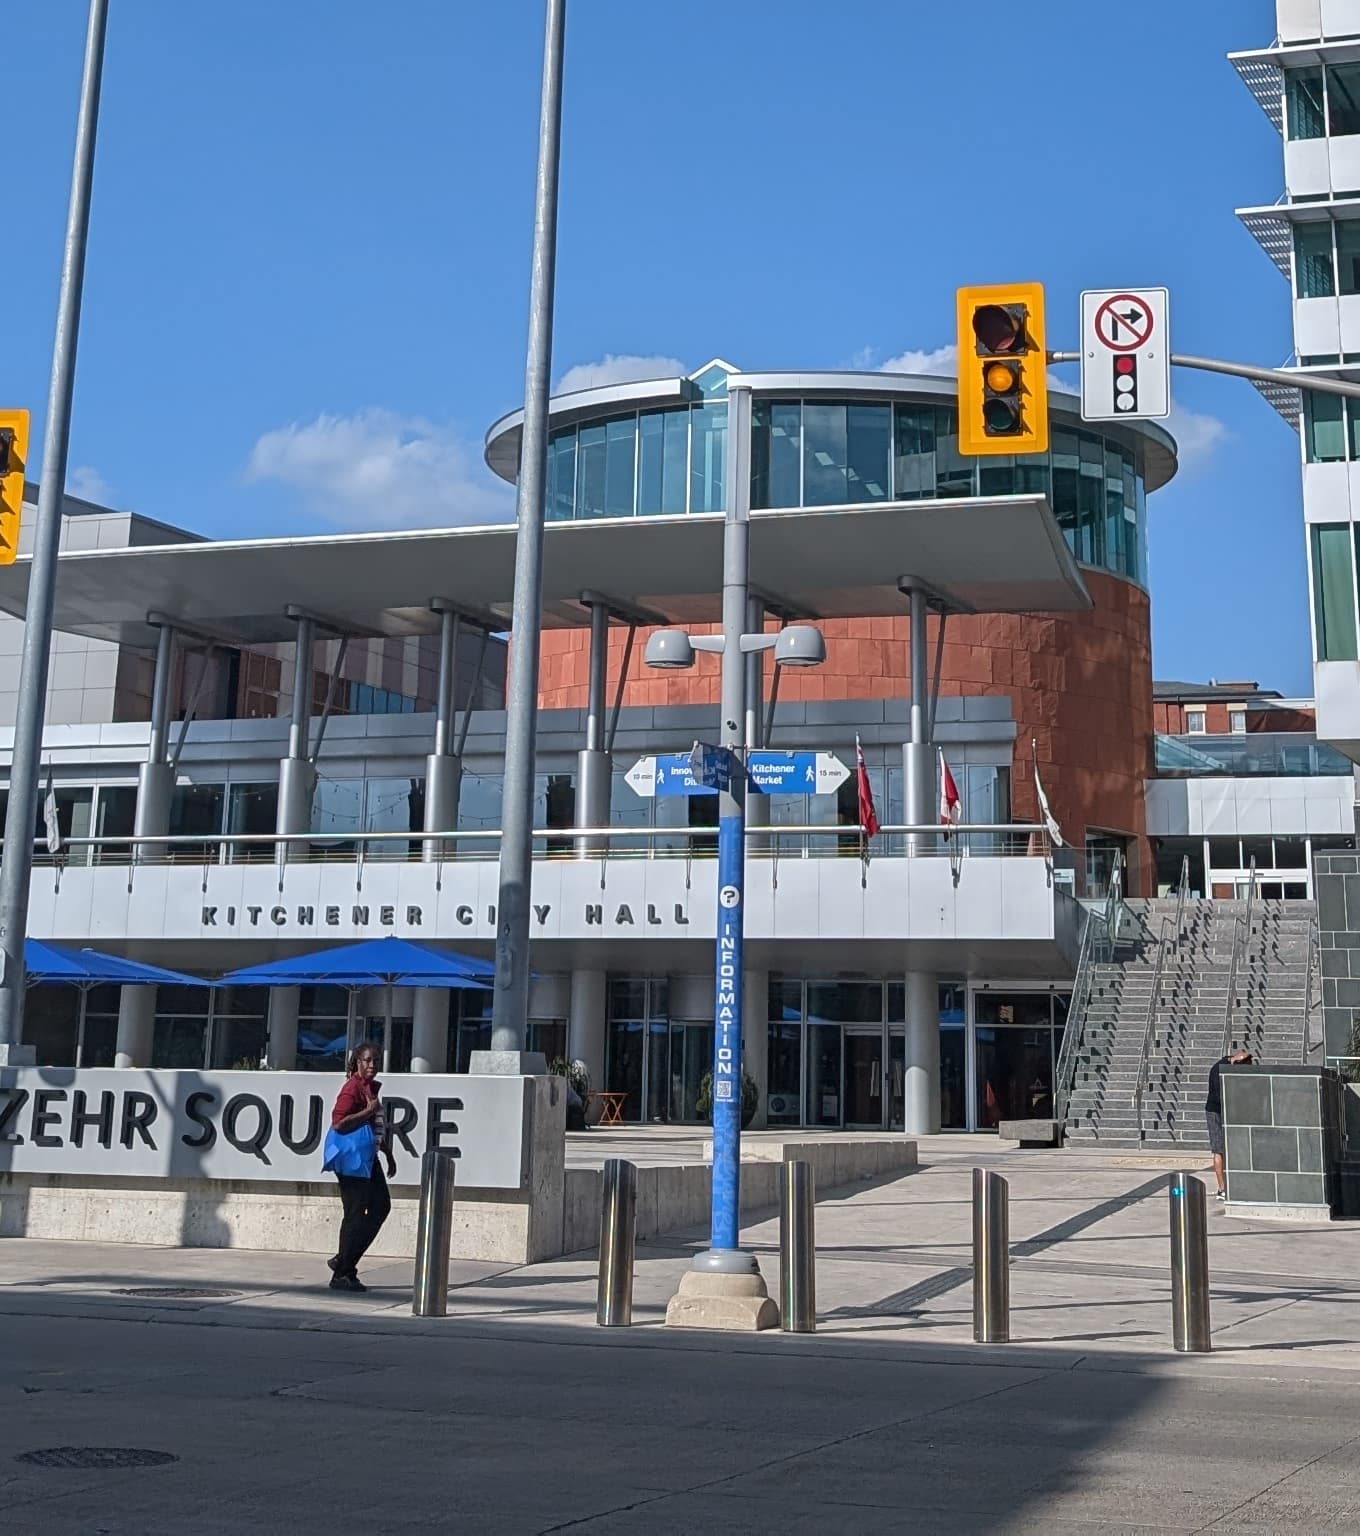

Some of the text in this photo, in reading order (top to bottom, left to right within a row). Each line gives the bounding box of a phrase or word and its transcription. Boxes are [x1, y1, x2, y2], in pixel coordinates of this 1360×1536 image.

[752, 764, 795, 773] Kitchener
[202, 904, 689, 925] KITCHENER CIY HALL
[717, 923, 735, 1074] INFORMATION
[181, 1091, 464, 1166] SQURE
